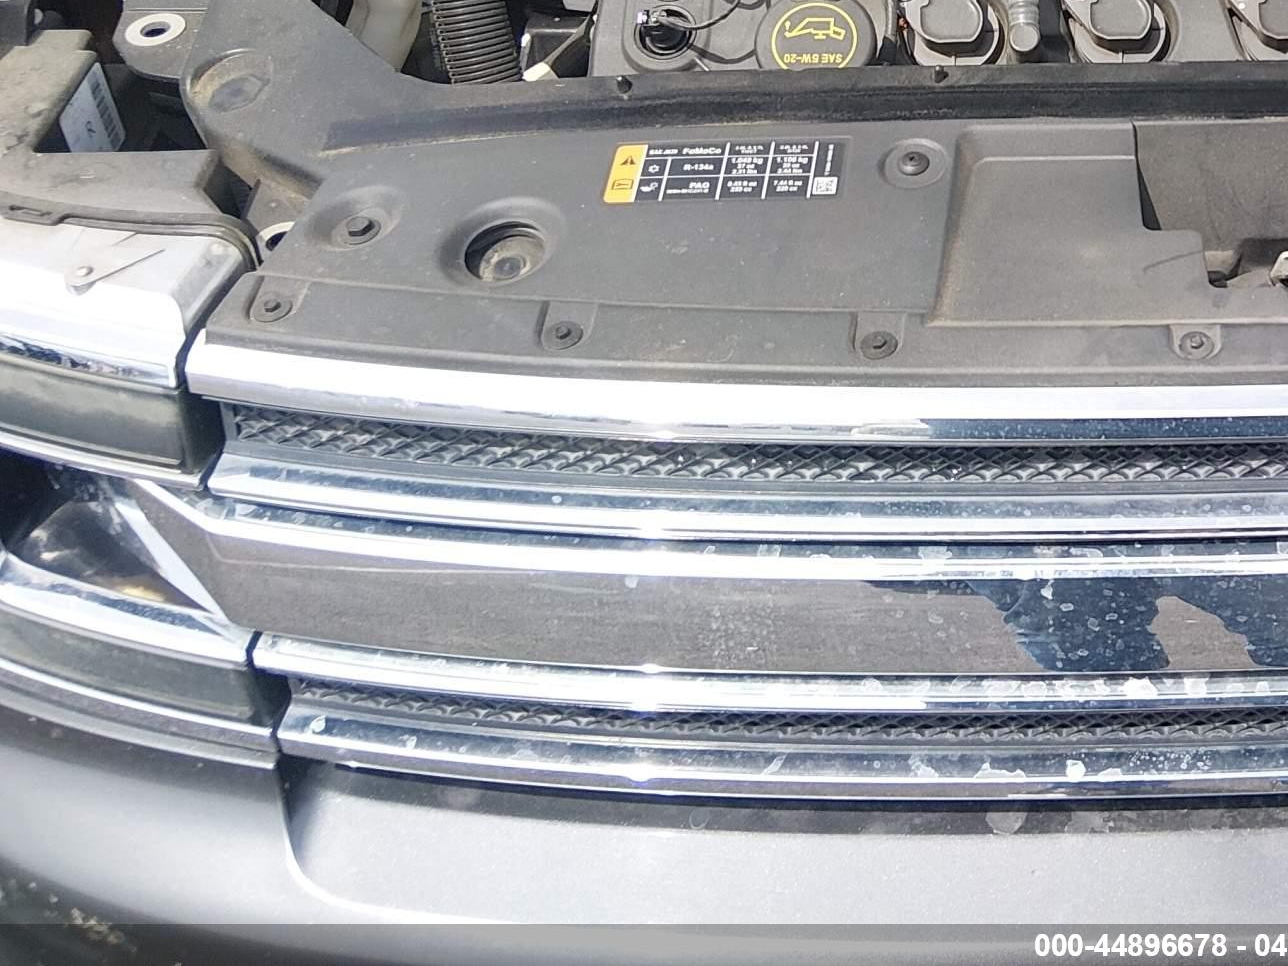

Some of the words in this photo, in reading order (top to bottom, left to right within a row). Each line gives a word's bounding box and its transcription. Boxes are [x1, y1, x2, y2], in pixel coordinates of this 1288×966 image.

[783, 53, 820, 64] 5W-20
[821, 53, 843, 64] SAE
[682, 147, 722, 155] FoMoCo
[683, 163, 714, 171] R-134a
